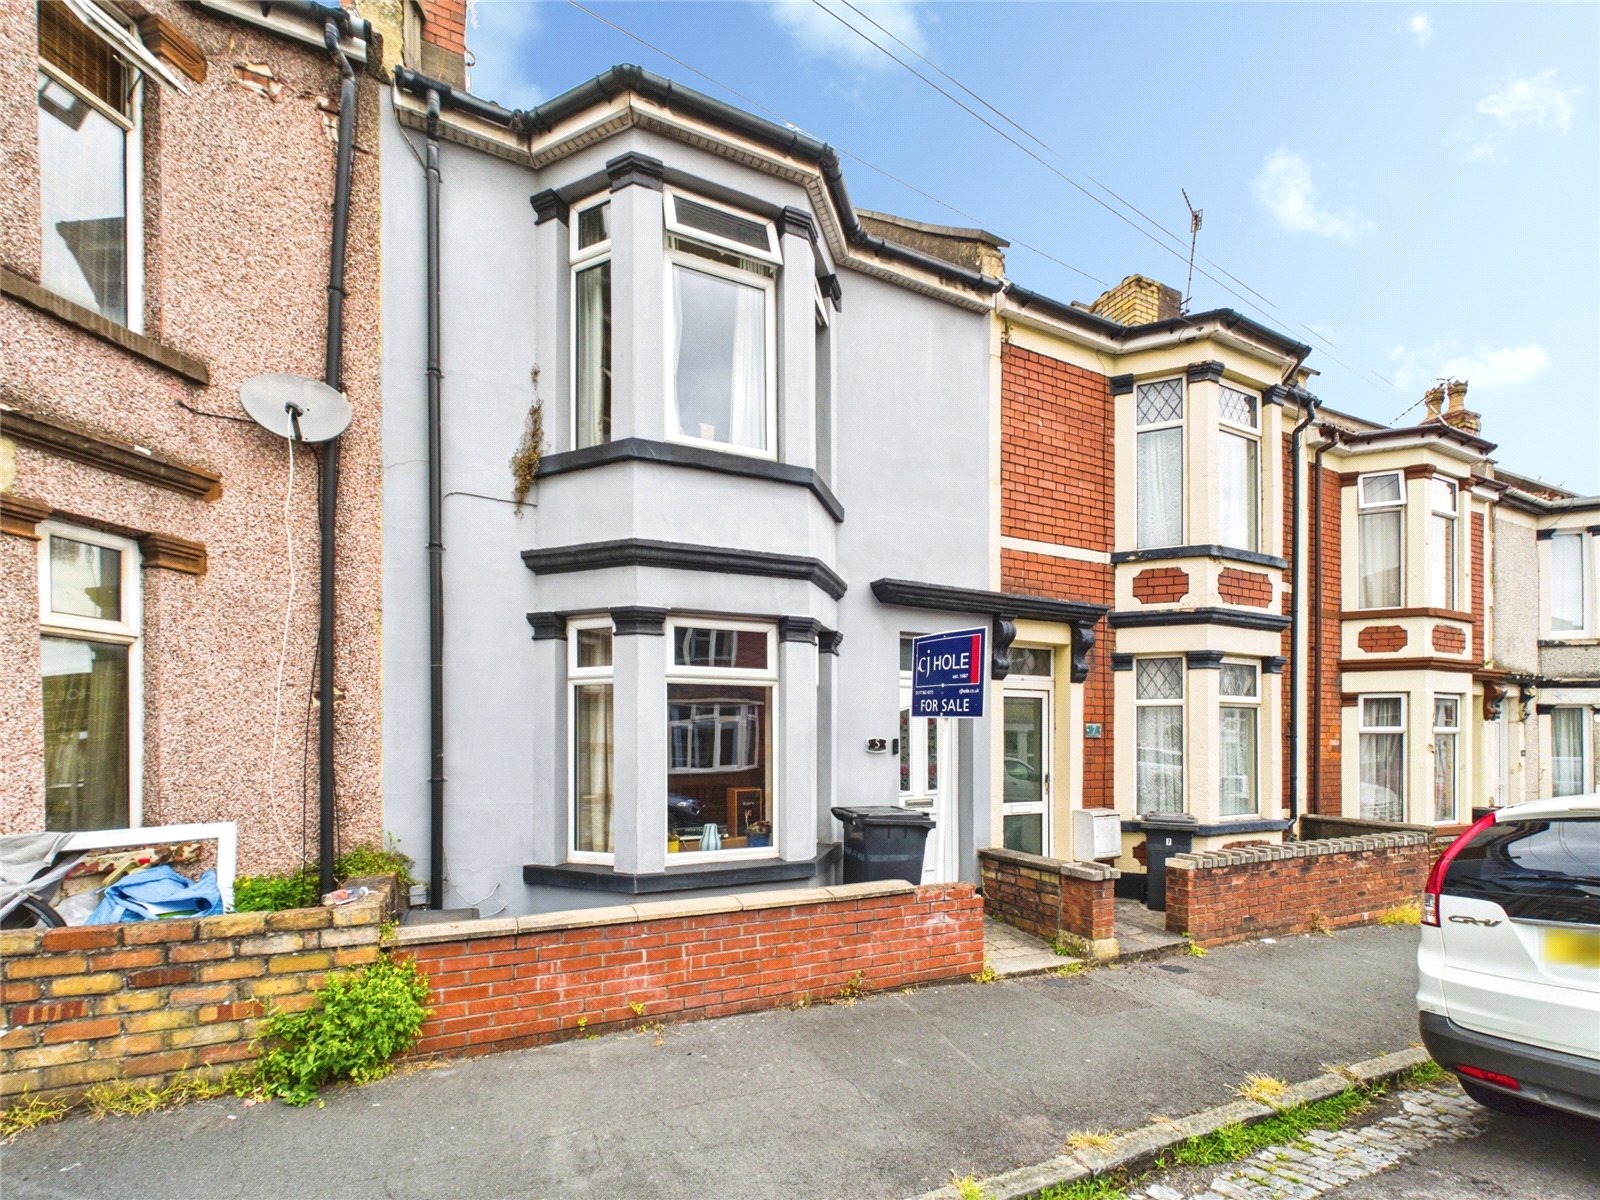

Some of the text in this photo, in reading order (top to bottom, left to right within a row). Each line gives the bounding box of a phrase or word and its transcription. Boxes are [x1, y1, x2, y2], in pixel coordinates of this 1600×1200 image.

[933, 652, 969, 670] HOLE
[920, 698, 970, 711] FOR SALE
[874, 738, 880, 749] 5
